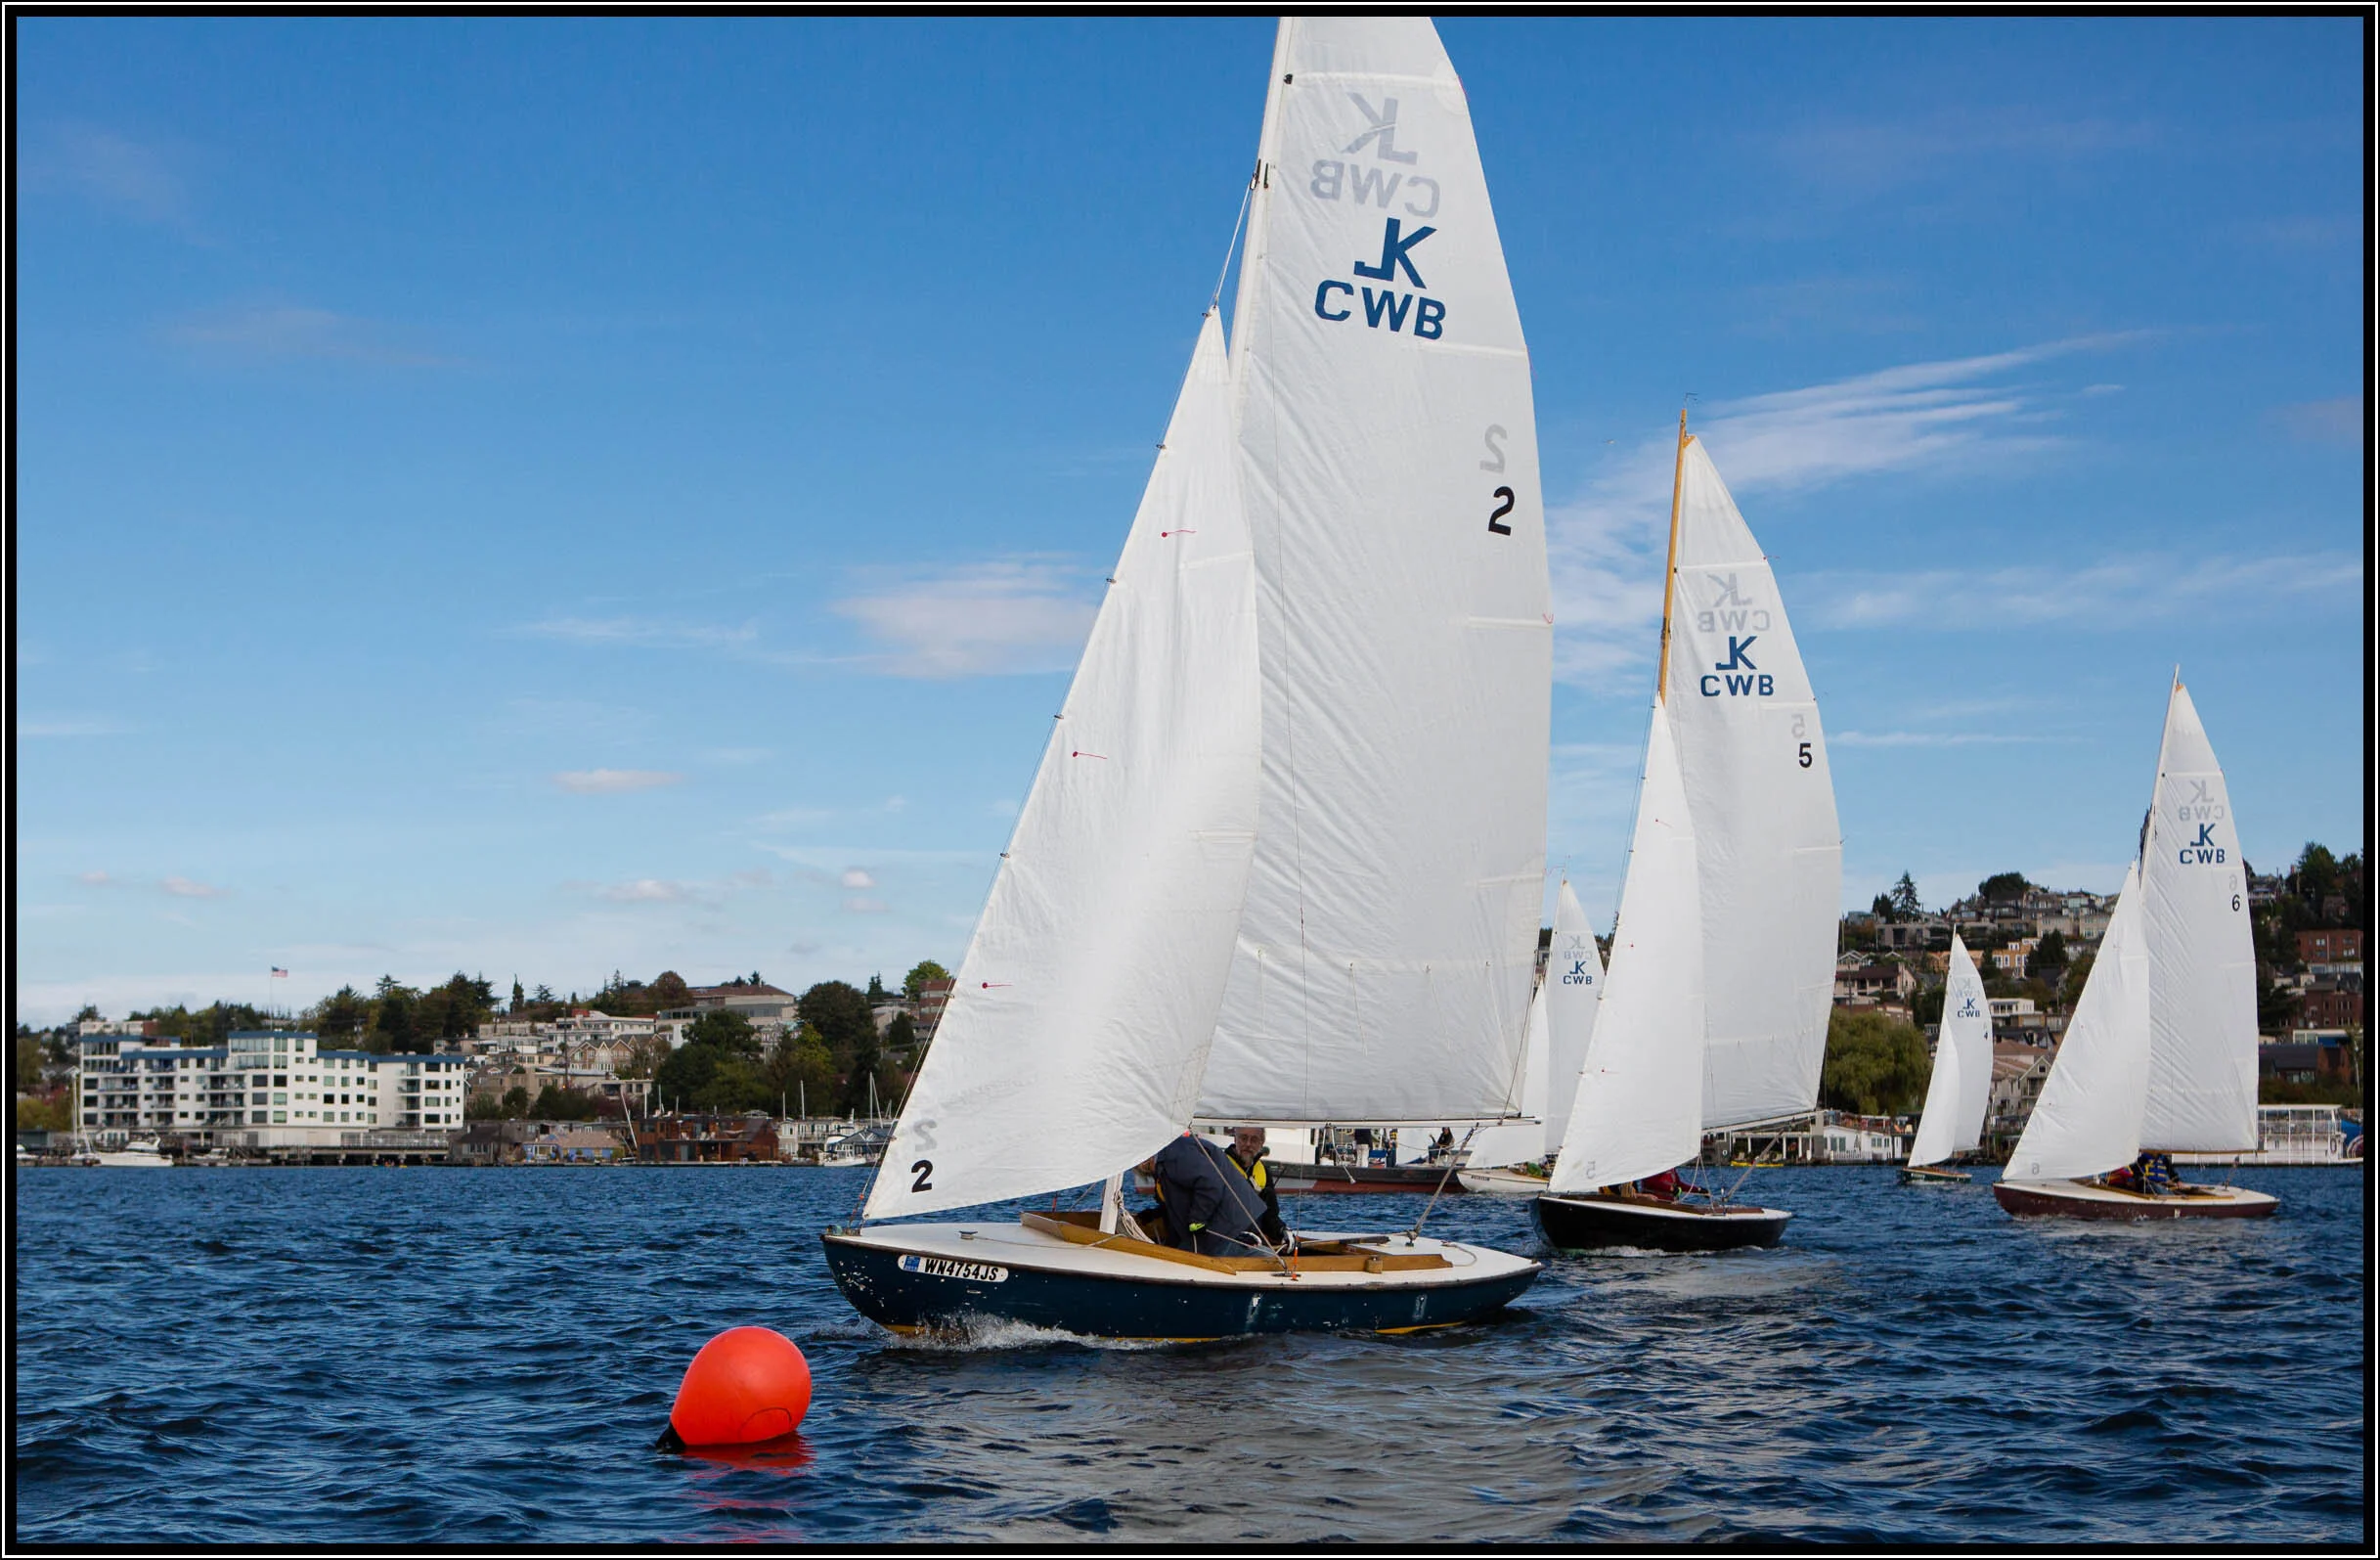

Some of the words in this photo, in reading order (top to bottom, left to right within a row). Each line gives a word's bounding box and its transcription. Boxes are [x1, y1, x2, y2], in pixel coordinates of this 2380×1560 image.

[1314, 279, 1446, 340] CWB
[1488, 485, 1515, 536] 2
[1700, 674, 1775, 697] CWB
[1798, 742, 1813, 769] 5
[2179, 848, 2226, 865] CWB
[2231, 894, 2241, 912] 6
[1563, 975, 1593, 985] CWB
[911, 1159, 934, 1193] 2
[924, 1258, 999, 1281] WN4754JS
